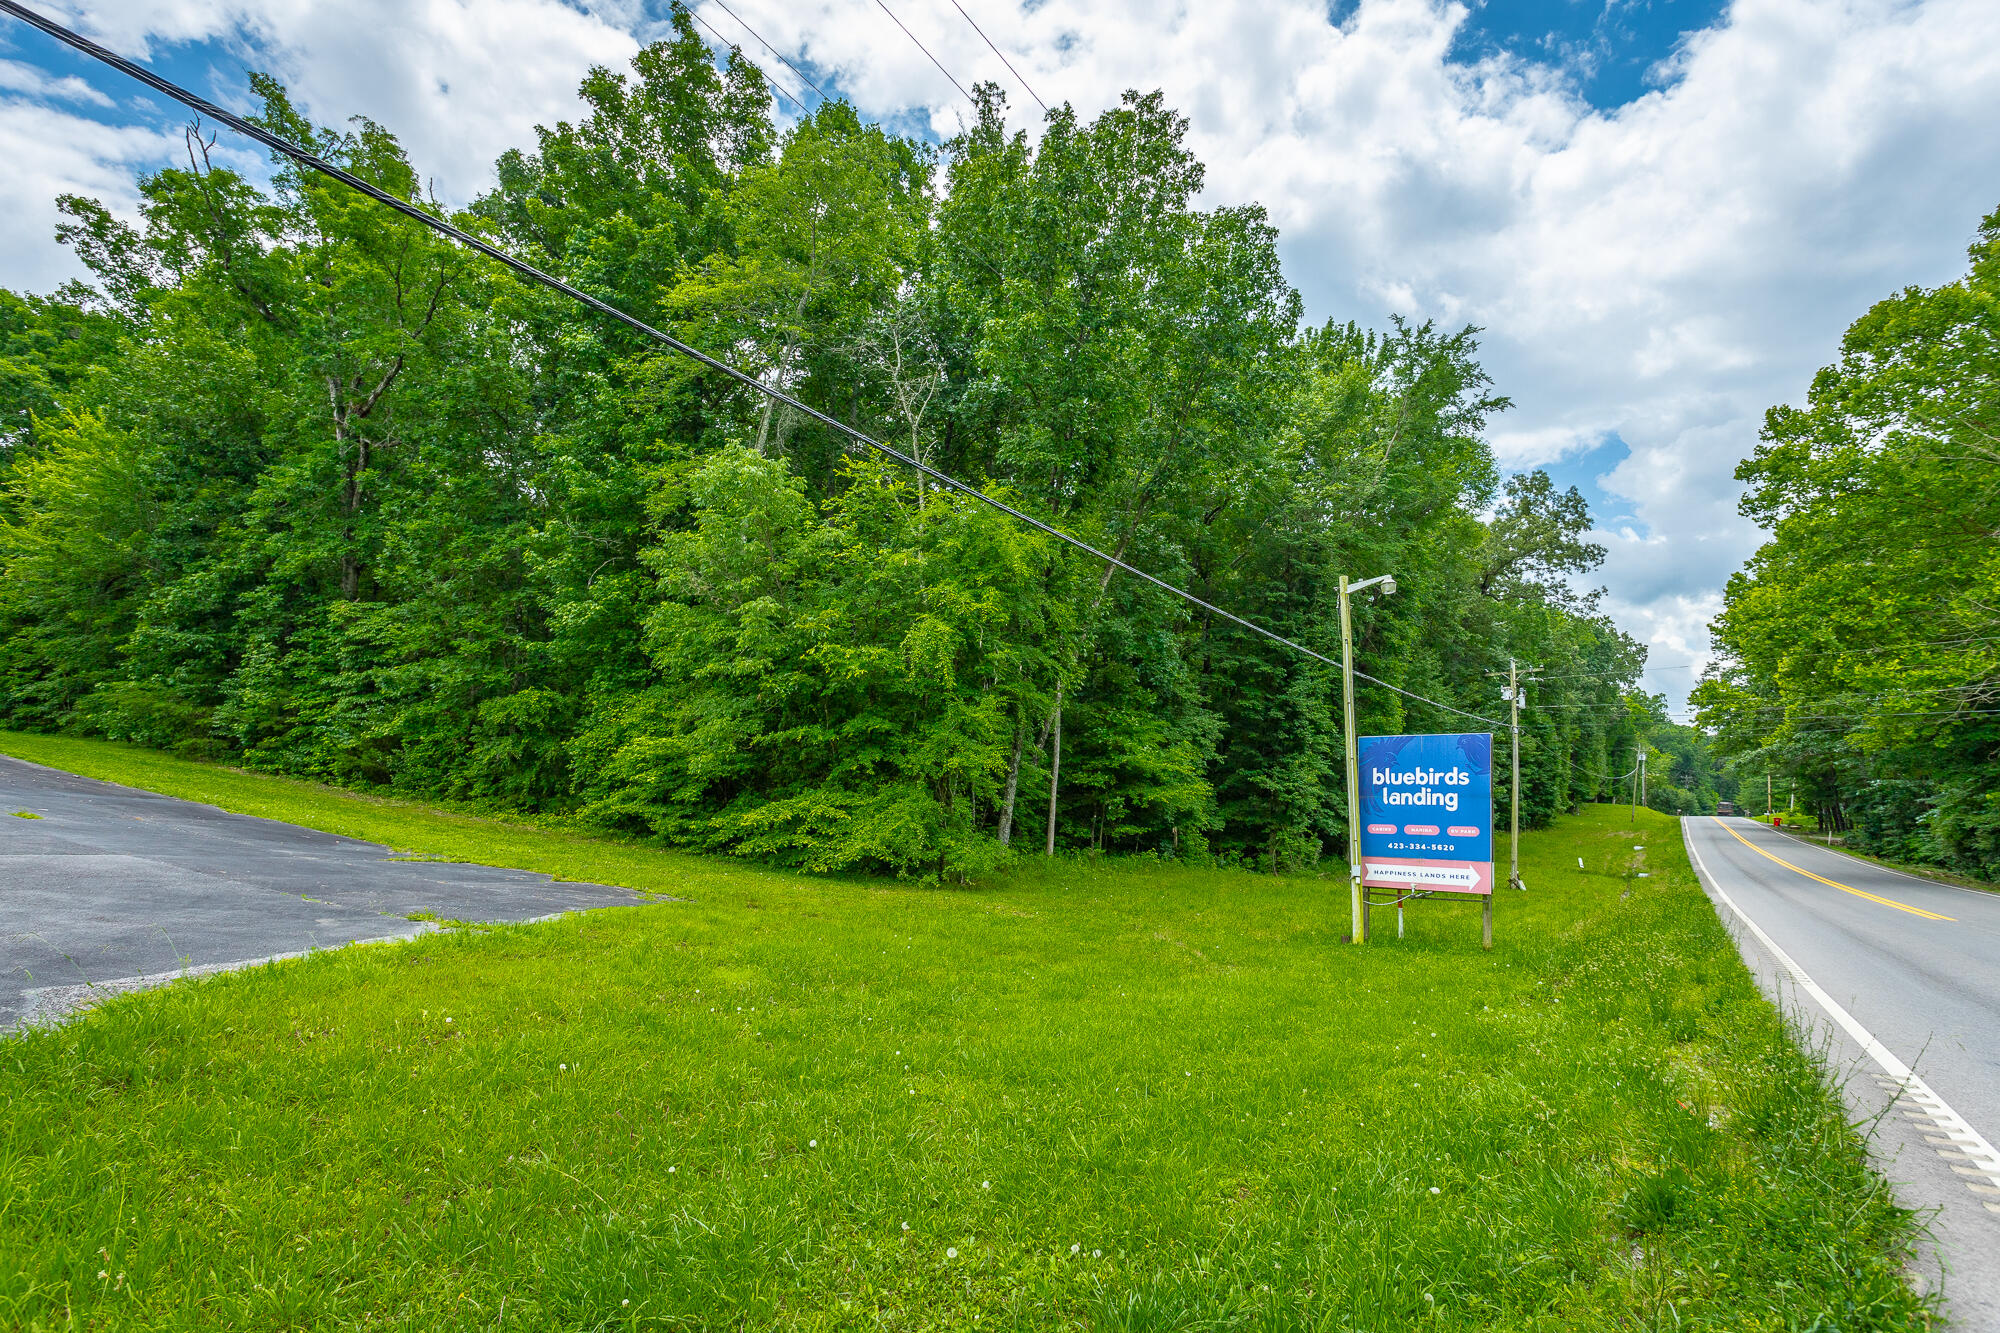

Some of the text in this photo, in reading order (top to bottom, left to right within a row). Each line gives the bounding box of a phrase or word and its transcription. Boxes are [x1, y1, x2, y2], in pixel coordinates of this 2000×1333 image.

[1372, 766, 1470, 785] bluebirds
[1382, 787, 1458, 811] landing
[1387, 842, 1455, 851] 423-334-5620
